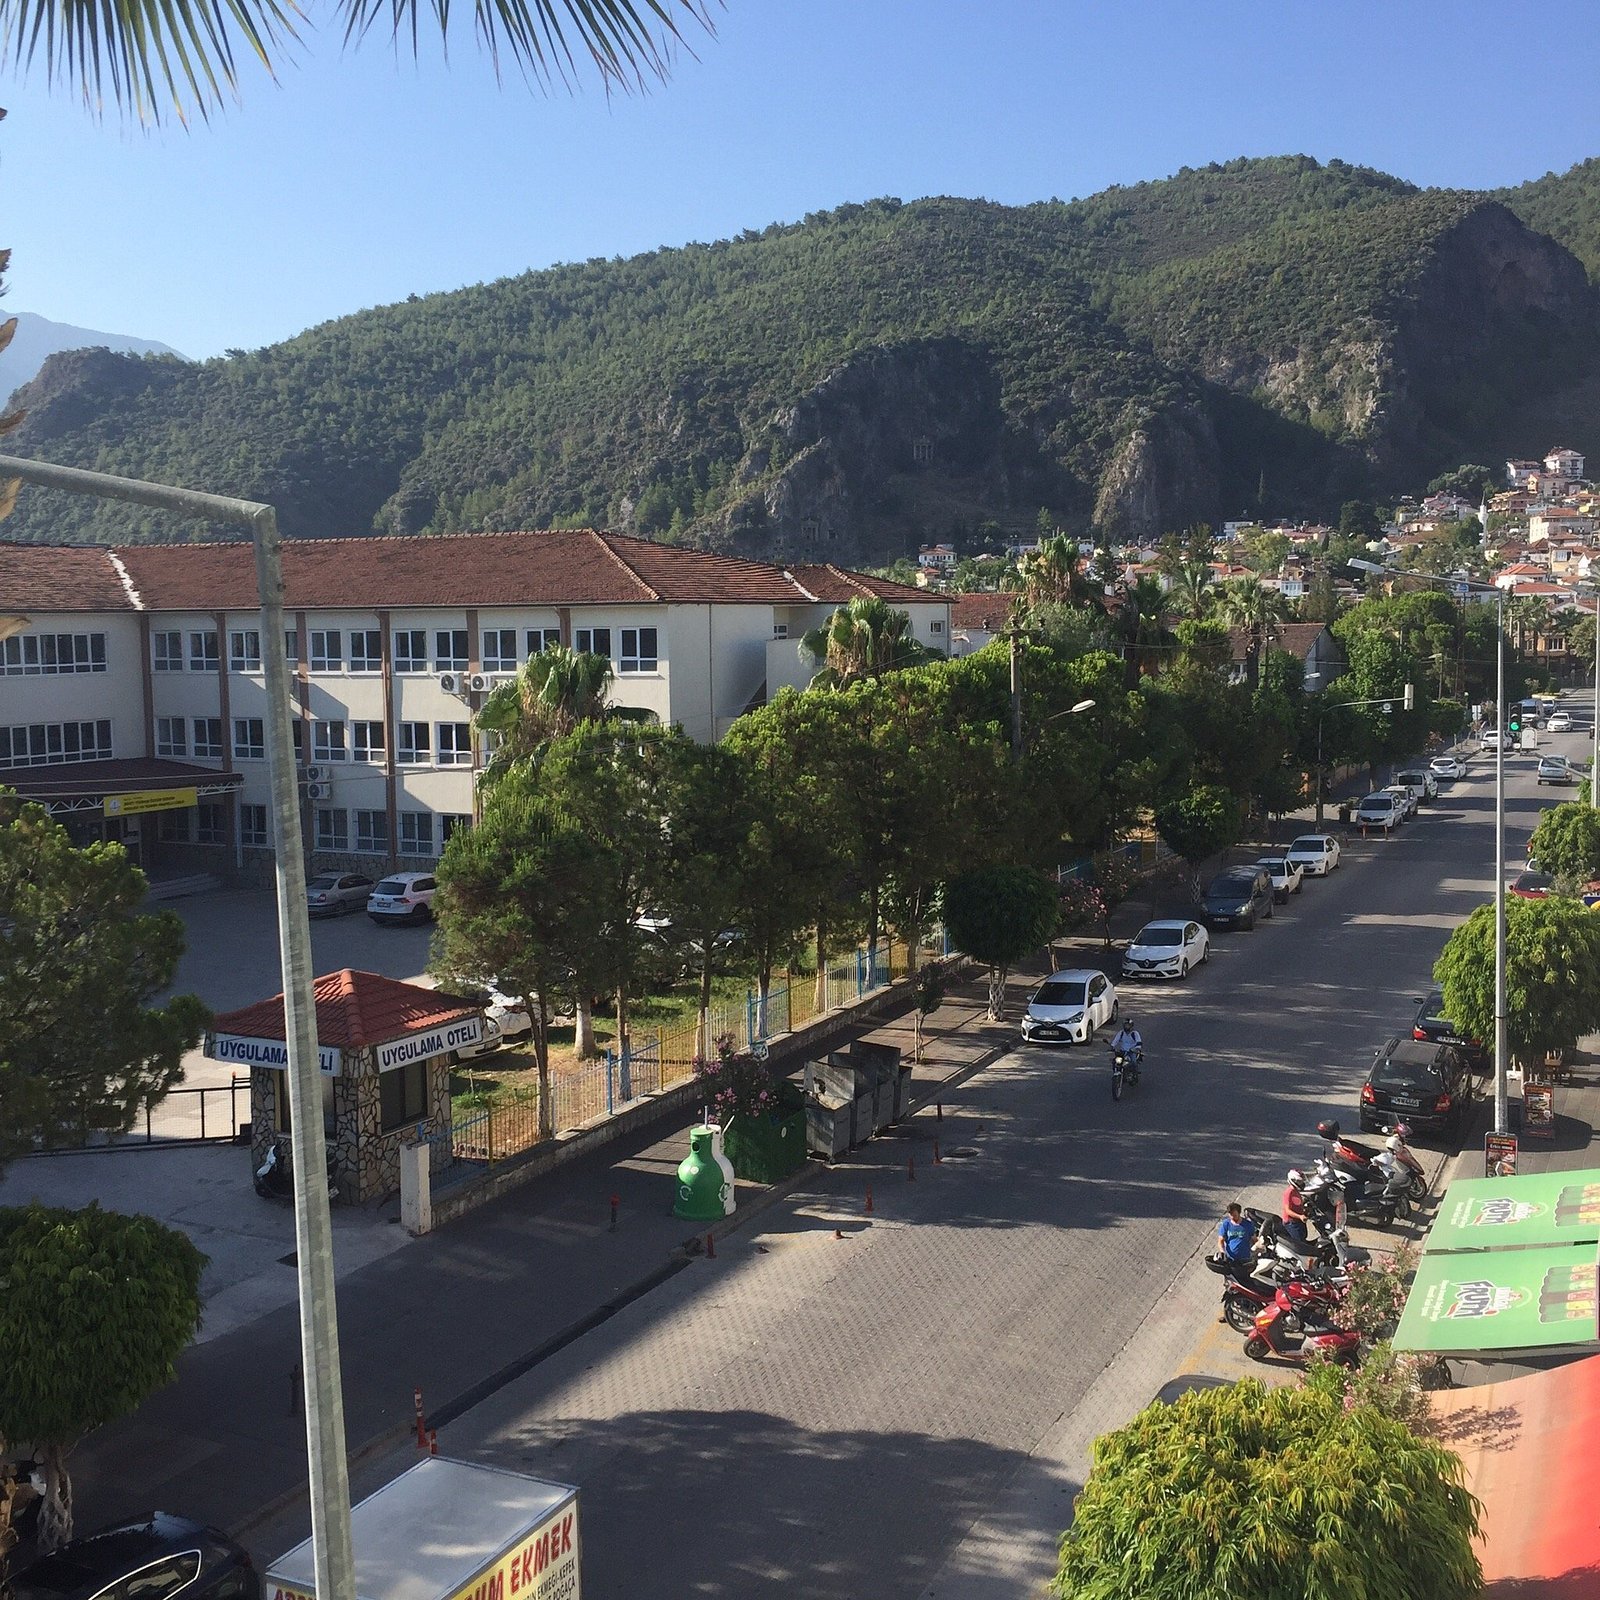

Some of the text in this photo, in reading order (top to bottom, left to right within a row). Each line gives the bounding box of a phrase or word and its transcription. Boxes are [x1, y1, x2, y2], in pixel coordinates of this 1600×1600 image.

[220, 1041, 288, 1065] UYGULAMA
[382, 1021, 478, 1067] UYGULAMA OTELİ
[510, 1512, 573, 1595] EKMEK
